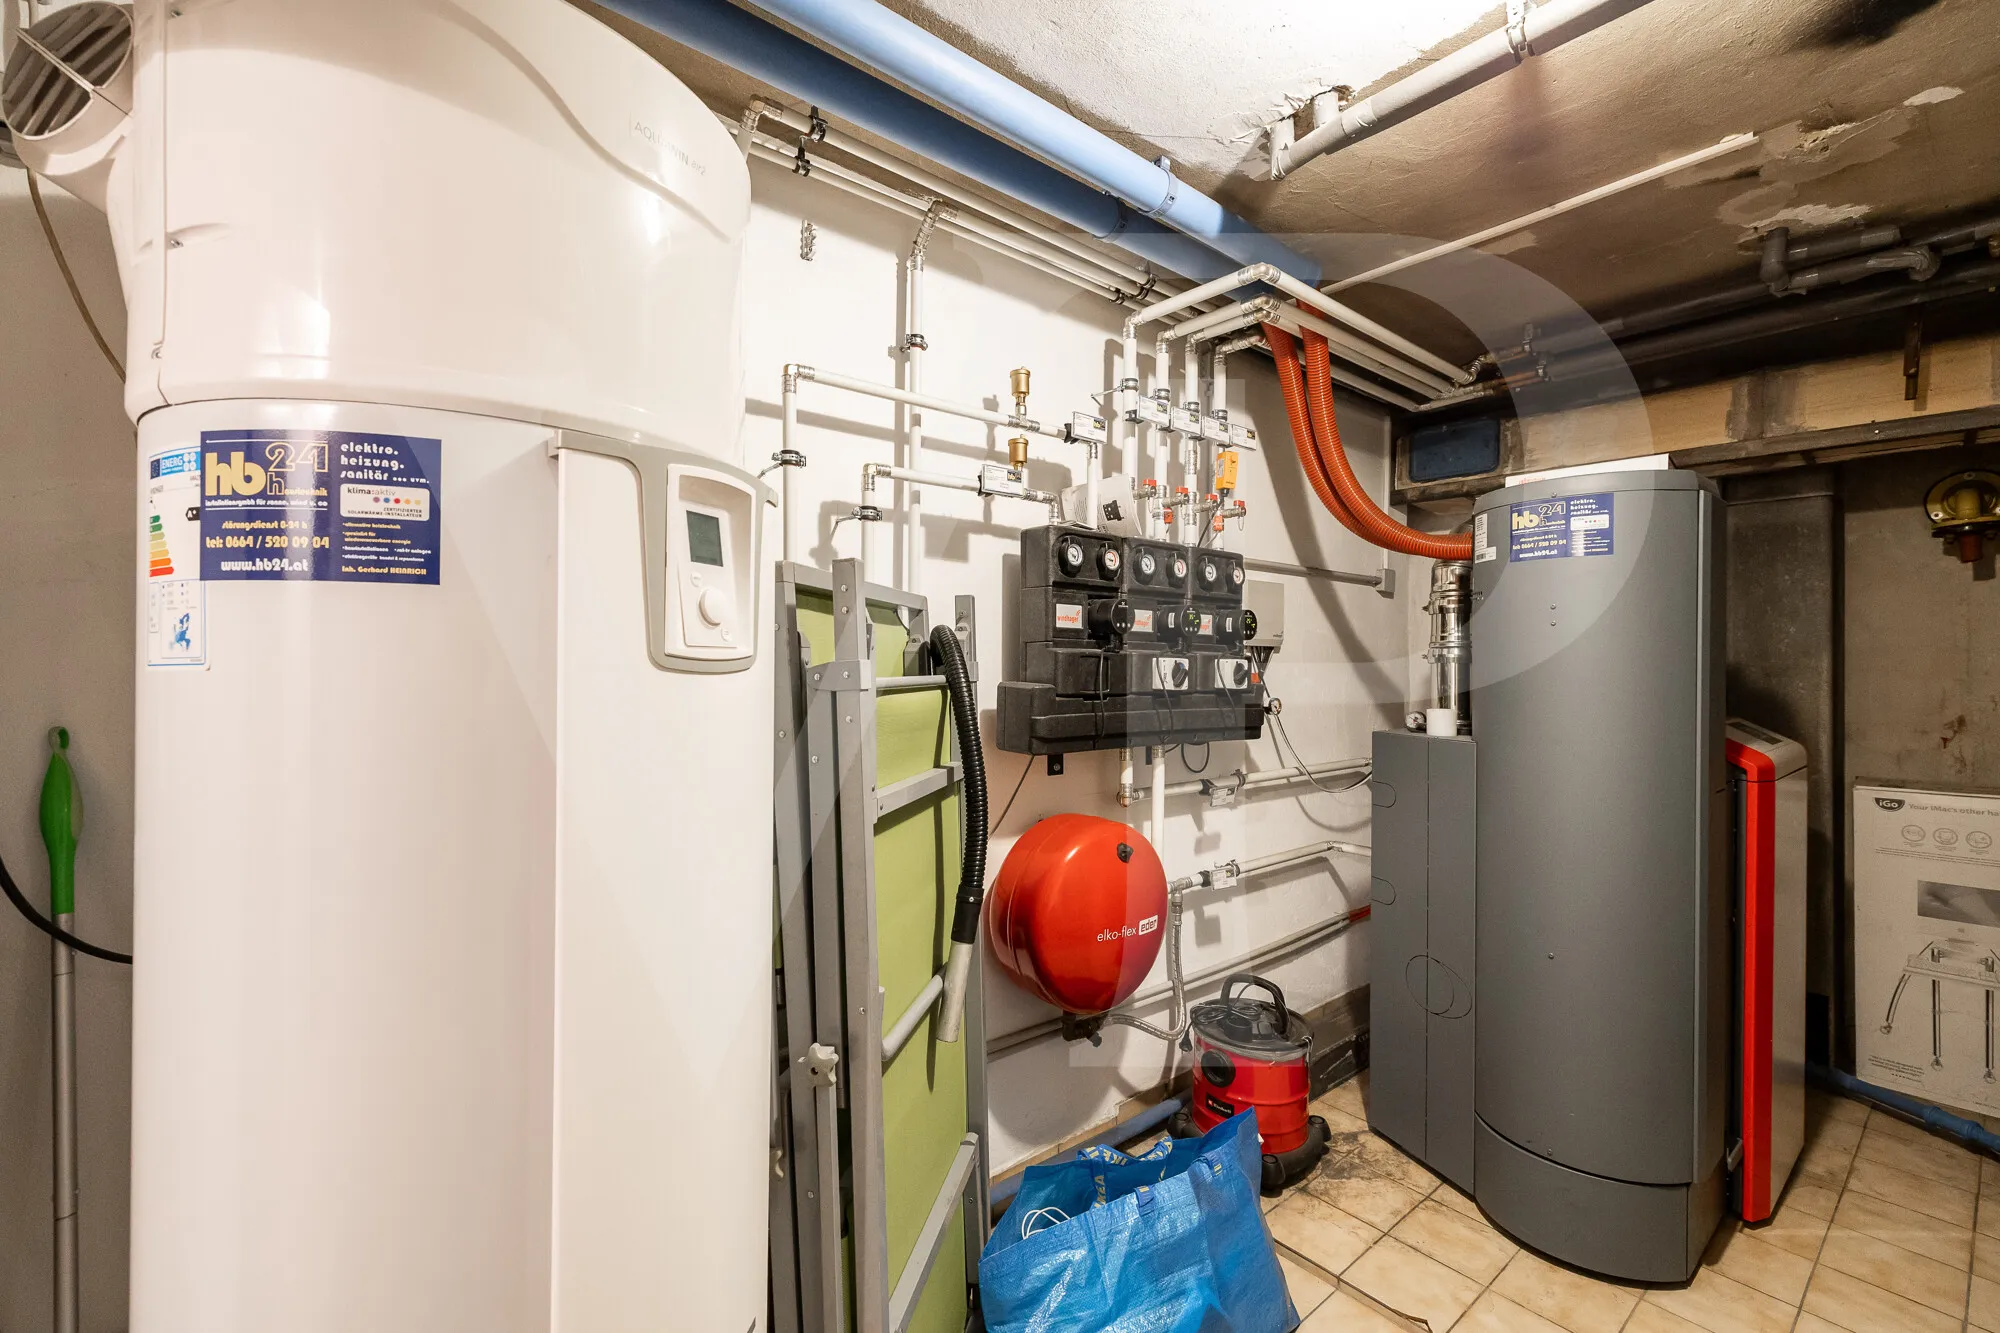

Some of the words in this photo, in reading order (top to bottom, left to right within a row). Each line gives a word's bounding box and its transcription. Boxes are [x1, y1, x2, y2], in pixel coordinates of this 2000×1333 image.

[340, 442, 399, 455] elektro.
[205, 451, 266, 496] hb
[265, 442, 329, 472] 24
[340, 455, 405, 471] heizung.
[340, 469, 389, 481] sanitär
[347, 487, 396, 497] klima:aktiv
[222, 520, 278, 531] störungsdienst
[1512, 510, 1540, 530] hb
[205, 536, 223, 548] tel:
[225, 536, 254, 548] 0664
[256, 536, 262, 549] /
[265, 536, 289, 548] 520
[291, 536, 309, 548] 09
[312, 536, 330, 549] 04
[221, 558, 309, 571] www.hb24.at
[357, 566, 388, 574] Gerhard
[390, 567, 427, 575] HEINRICH
[1879, 799, 1899, 808] iGo
[1908, 803, 1928, 811] Your
[1930, 804, 1957, 813] iMac's
[1959, 808, 1985, 816] other
[1140, 919, 1157, 932] eder
[1097, 926, 1137, 942] elko-flex
